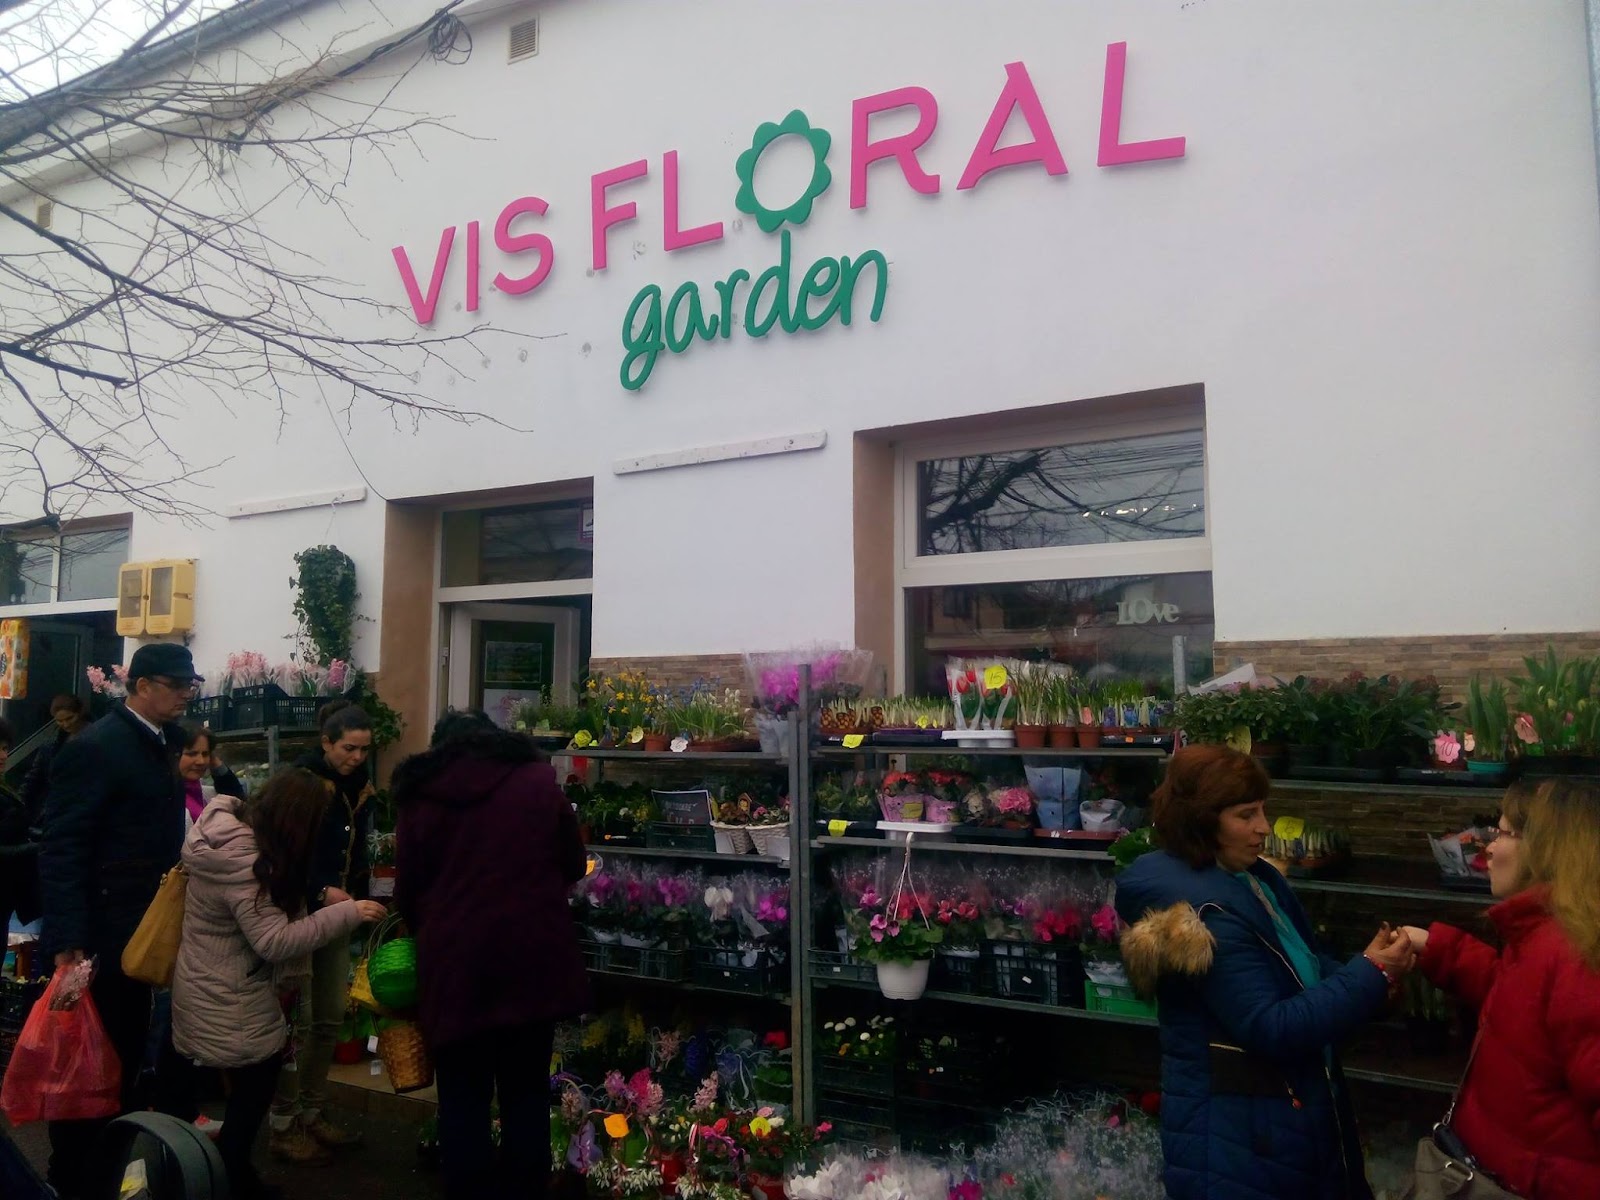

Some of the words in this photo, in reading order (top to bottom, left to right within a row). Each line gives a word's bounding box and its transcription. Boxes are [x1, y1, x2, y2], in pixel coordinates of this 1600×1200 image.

[393, 197, 554, 325] VIS
[592, 43, 1186, 269] FLORAL
[621, 229, 888, 390] garden
[1441, 742, 1453, 756] 10
